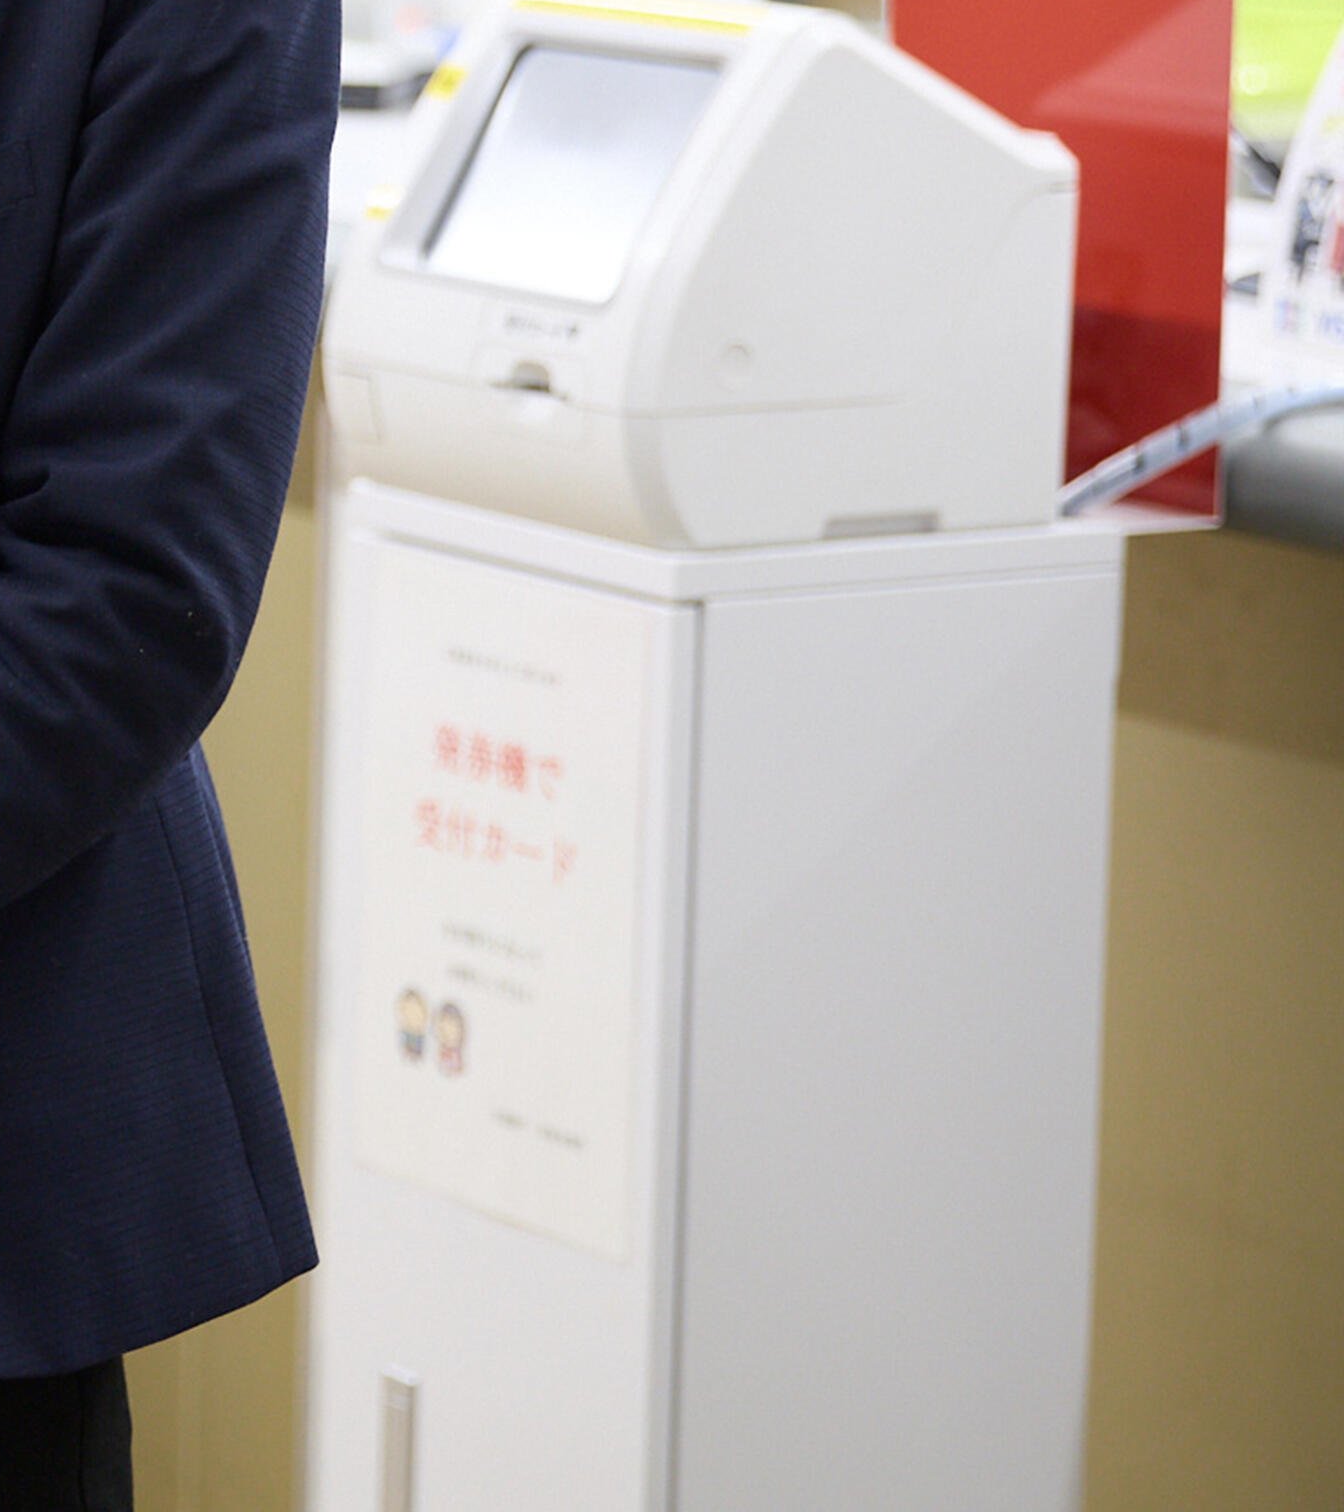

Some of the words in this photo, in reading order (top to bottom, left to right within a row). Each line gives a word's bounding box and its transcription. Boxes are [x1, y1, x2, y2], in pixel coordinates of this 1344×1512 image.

[432, 722, 563, 802] 発券機で
[414, 796, 579, 886] 受付カード
